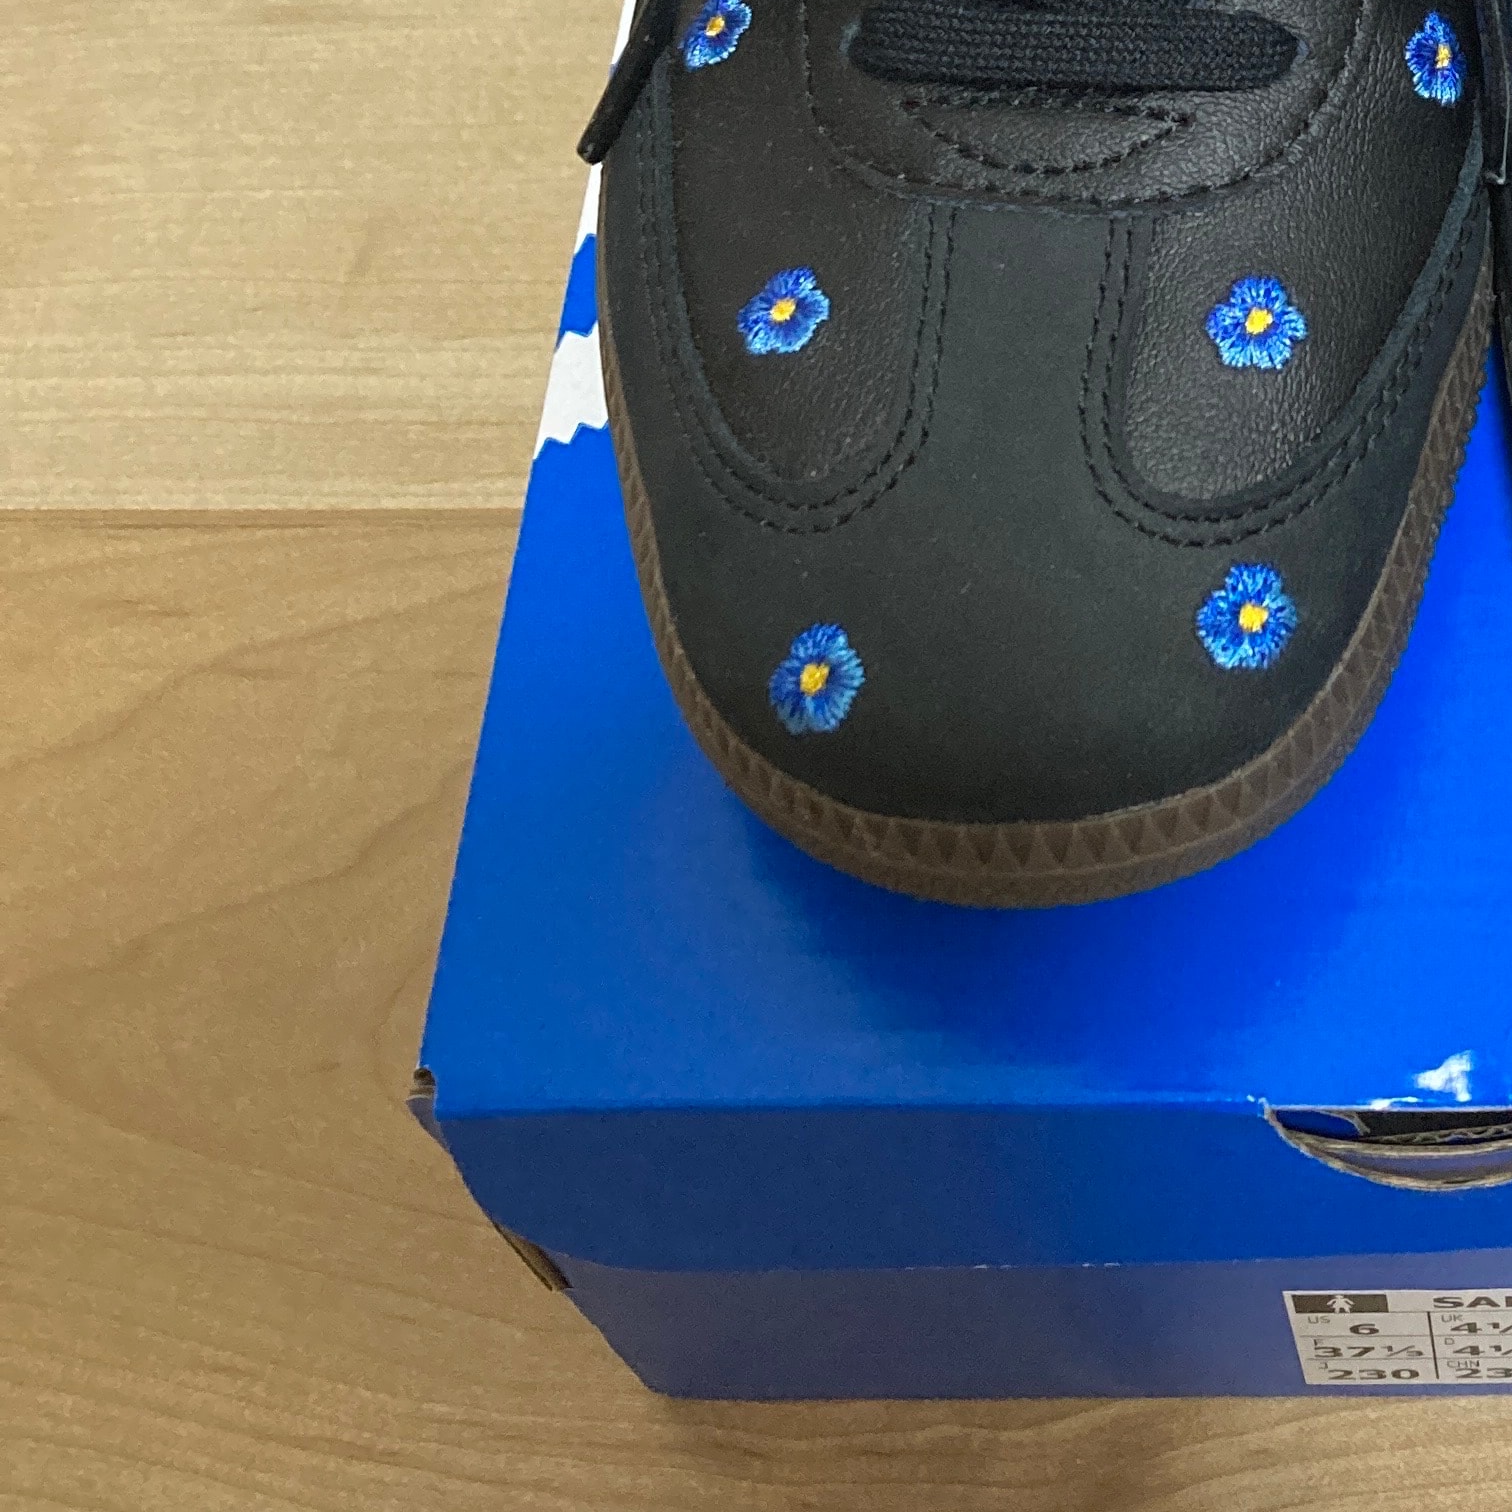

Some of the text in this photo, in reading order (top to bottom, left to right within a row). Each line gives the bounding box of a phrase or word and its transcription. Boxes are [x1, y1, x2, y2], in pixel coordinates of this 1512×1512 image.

[1307, 1315, 1331, 1325] US
[1441, 1314, 1464, 1323] UK
[1349, 1323, 1380, 1335] 6
[1444, 1337, 1455, 1346] D
[1446, 1360, 1481, 1368] CHN
[1328, 1369, 1420, 1381] 230
